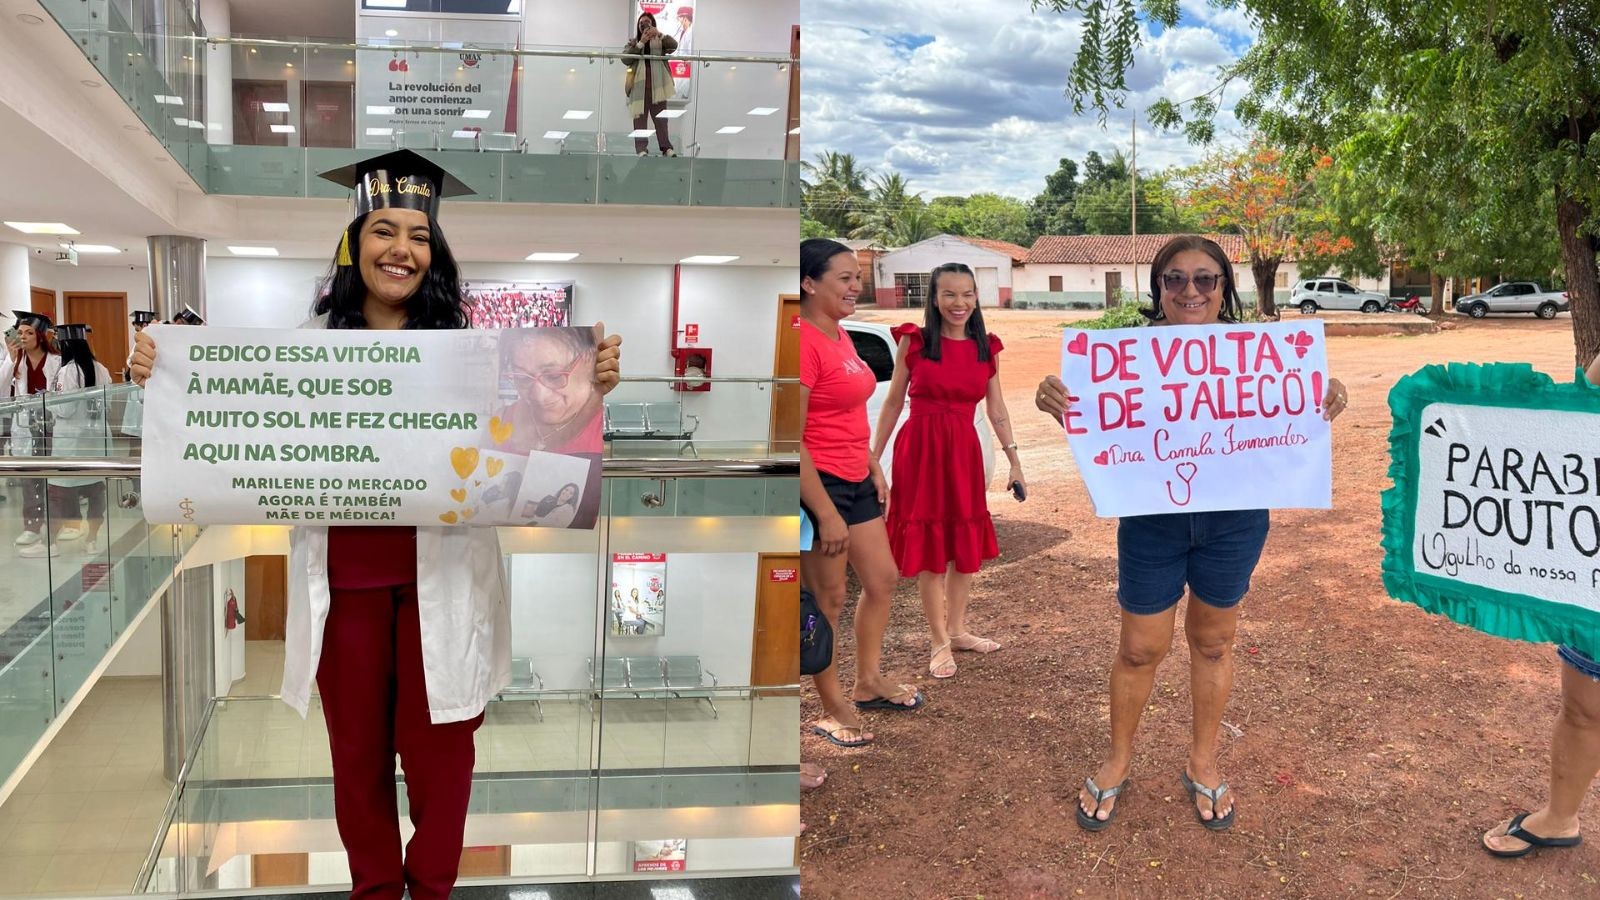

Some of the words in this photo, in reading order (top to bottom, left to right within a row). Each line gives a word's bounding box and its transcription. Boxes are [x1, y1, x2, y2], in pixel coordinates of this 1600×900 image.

[460, 53, 481, 61] UMAX
[389, 82, 402, 91] La
[405, 82, 462, 93] revolución
[464, 83, 481, 93] del
[389, 94, 418, 104] amor
[420, 95, 472, 104] comienza
[391, 107, 409, 116] on
[411, 107, 432, 116] una
[370, 178, 393, 196] Dra.
[395, 176, 431, 198] Camila
[189, 345, 271, 362] DEDICO
[275, 346, 329, 363] ESSA
[332, 341, 421, 363] VITÓRIA
[1090, 338, 1141, 384] DE
[187, 371, 203, 395] À
[206, 372, 294, 398] MAMÃE,
[297, 377, 344, 399] QUE
[347, 378, 393, 396] SOB
[186, 410, 260, 428] MUITO
[263, 410, 306, 429] SOL
[309, 411, 342, 429] ME
[346, 412, 385, 429] FEZ
[388, 412, 478, 430] CHEGAR
[1098, 386, 1146, 432] DE
[183, 443, 240, 465] AQUI
[244, 443, 277, 462] NA
[280, 444, 380, 463] SOMBRA.
[1109, 444, 1145, 465] Dra.
[1154, 428, 1215, 462] Camila
[1221, 423, 1309, 455] Fernandes
[1446, 442, 1600, 496] PARAB
[232, 477, 315, 490] MARILENE
[319, 478, 343, 490] DO
[347, 478, 427, 491] MERCADO
[258, 495, 315, 506] AGORA
[319, 492, 329, 506] É
[333, 493, 402, 507] TAMBÉM
[266, 508, 300, 520] MÃE
[304, 511, 325, 520] DE
[329, 509, 396, 520] MÉDICA!
[1503, 549, 1522, 575] da
[1529, 567, 1576, 583] nossa
